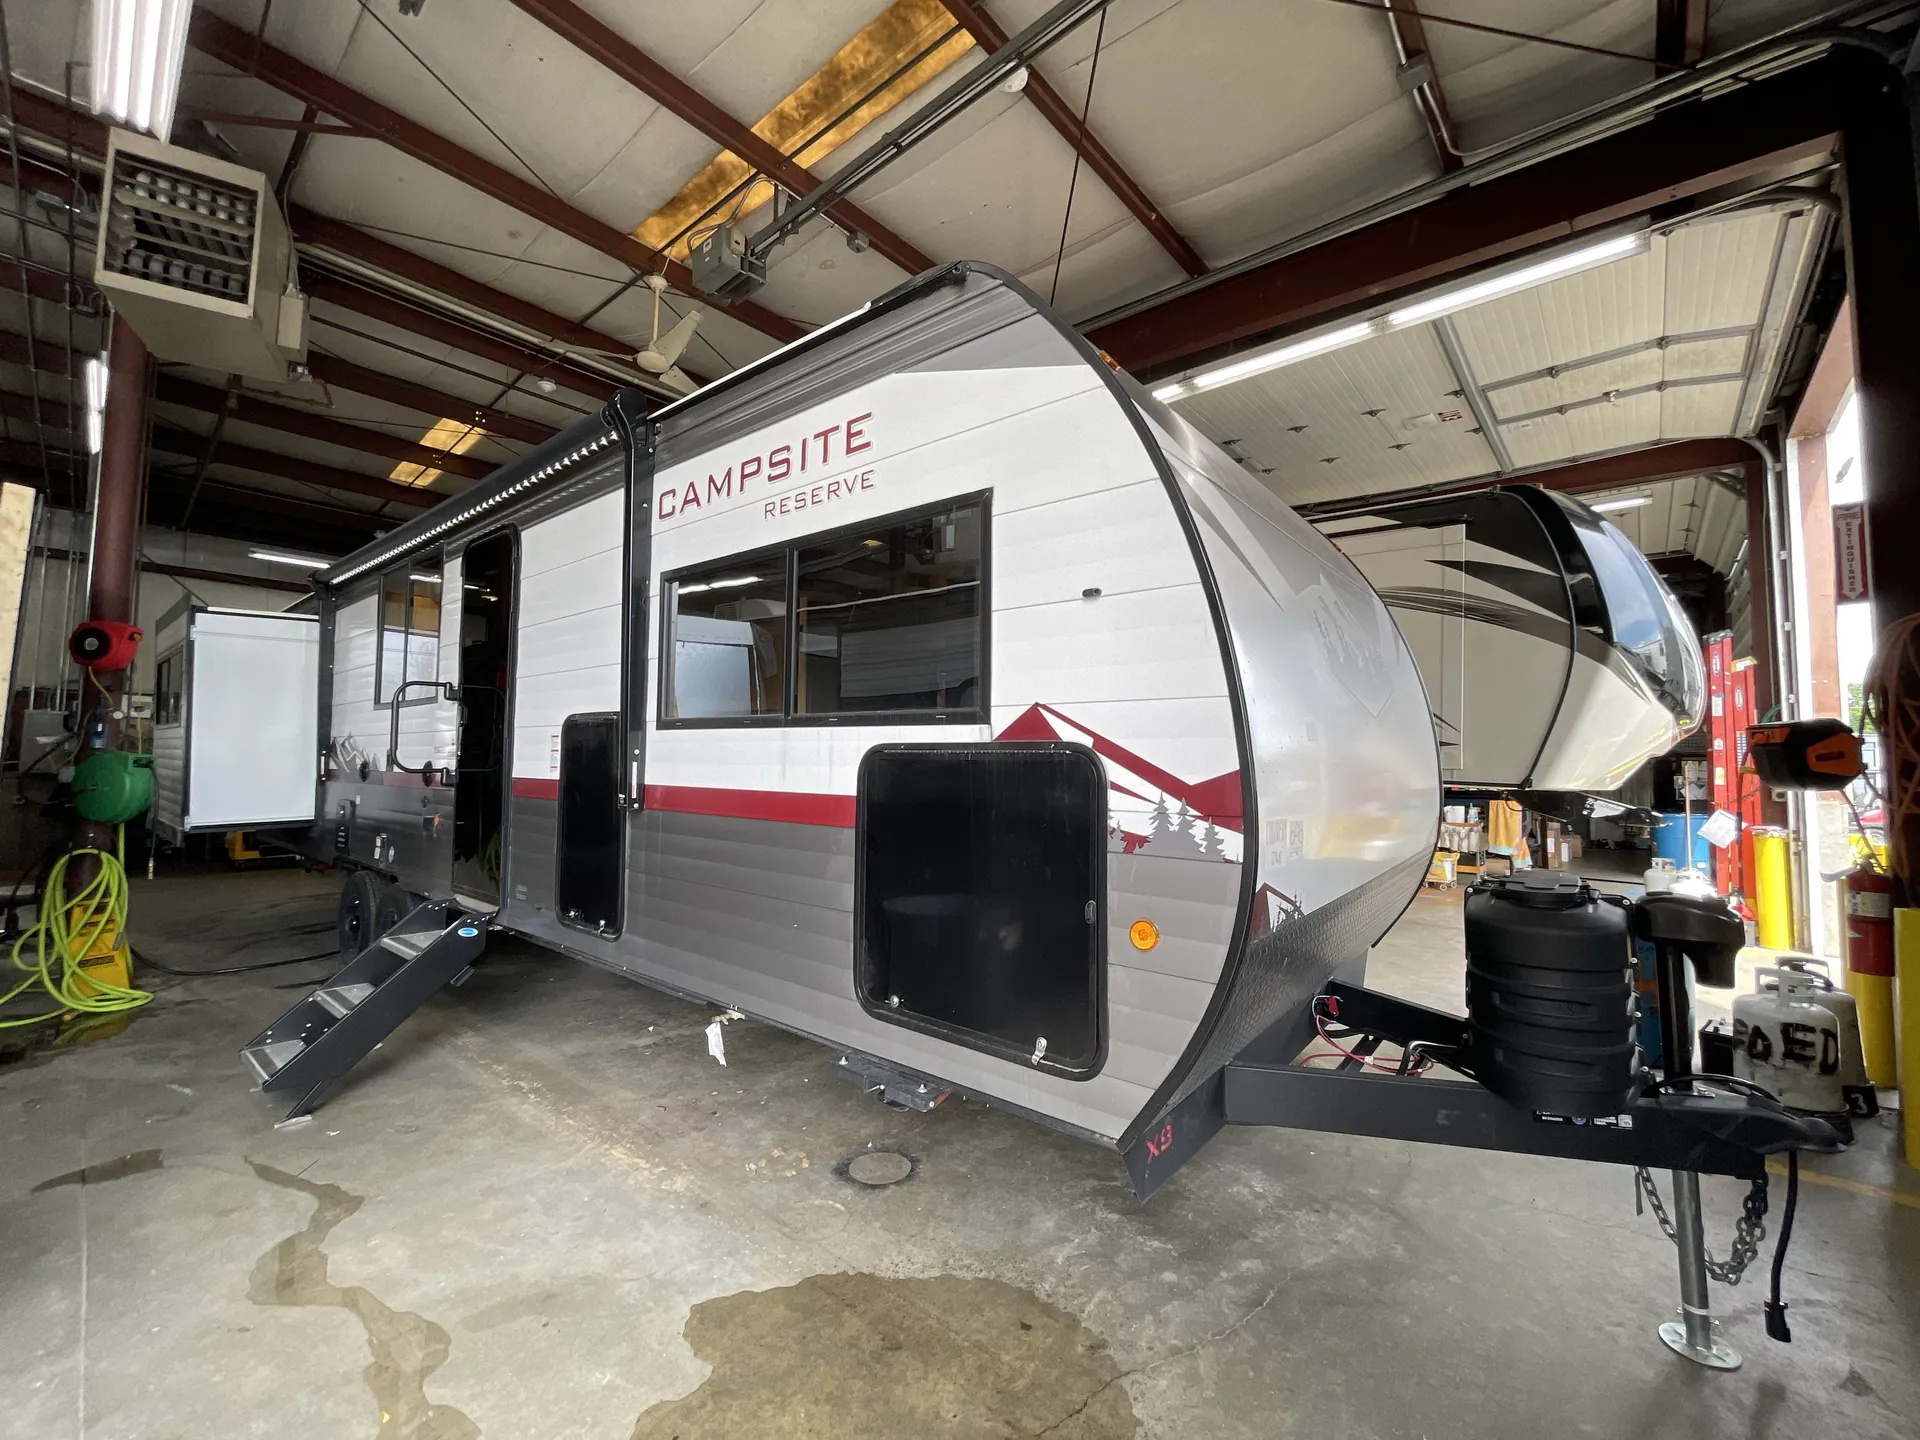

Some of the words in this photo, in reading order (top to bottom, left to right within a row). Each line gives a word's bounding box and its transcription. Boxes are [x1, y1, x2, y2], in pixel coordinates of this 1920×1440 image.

[658, 411, 873, 520] CAMPSITE
[764, 469, 875, 519] RESERVE
[1837, 511, 1861, 520] FIRE
[1845, 521, 1857, 593] EXTINGUISHER
[1850, 1093, 1869, 1116] 3
